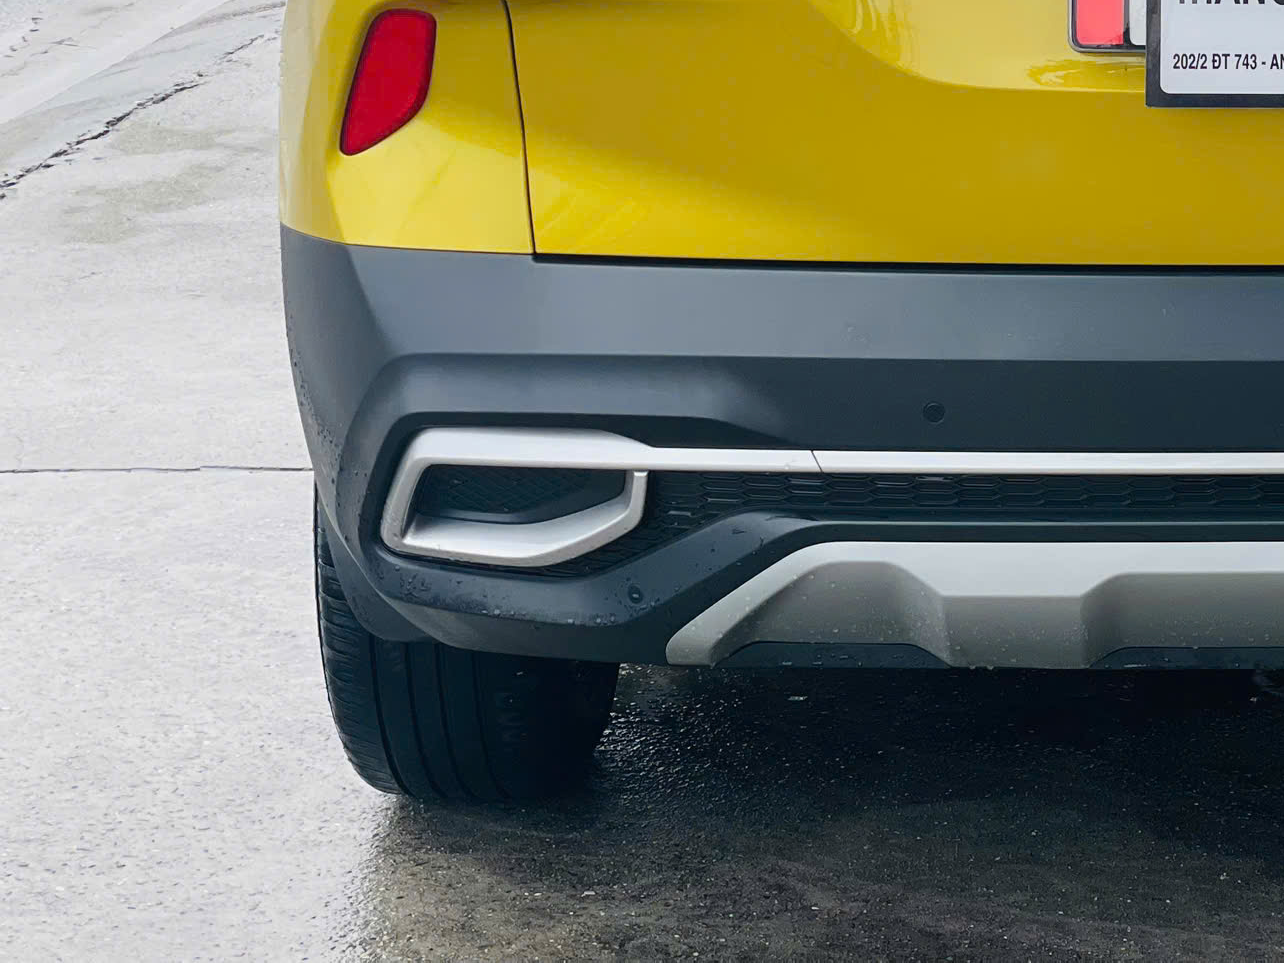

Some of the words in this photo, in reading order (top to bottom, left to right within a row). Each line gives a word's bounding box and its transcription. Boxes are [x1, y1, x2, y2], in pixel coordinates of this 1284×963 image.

[1172, 53, 1208, 70] 202/2
[1212, 53, 1231, 70] ĐT
[1234, 53, 1258, 70] 743
